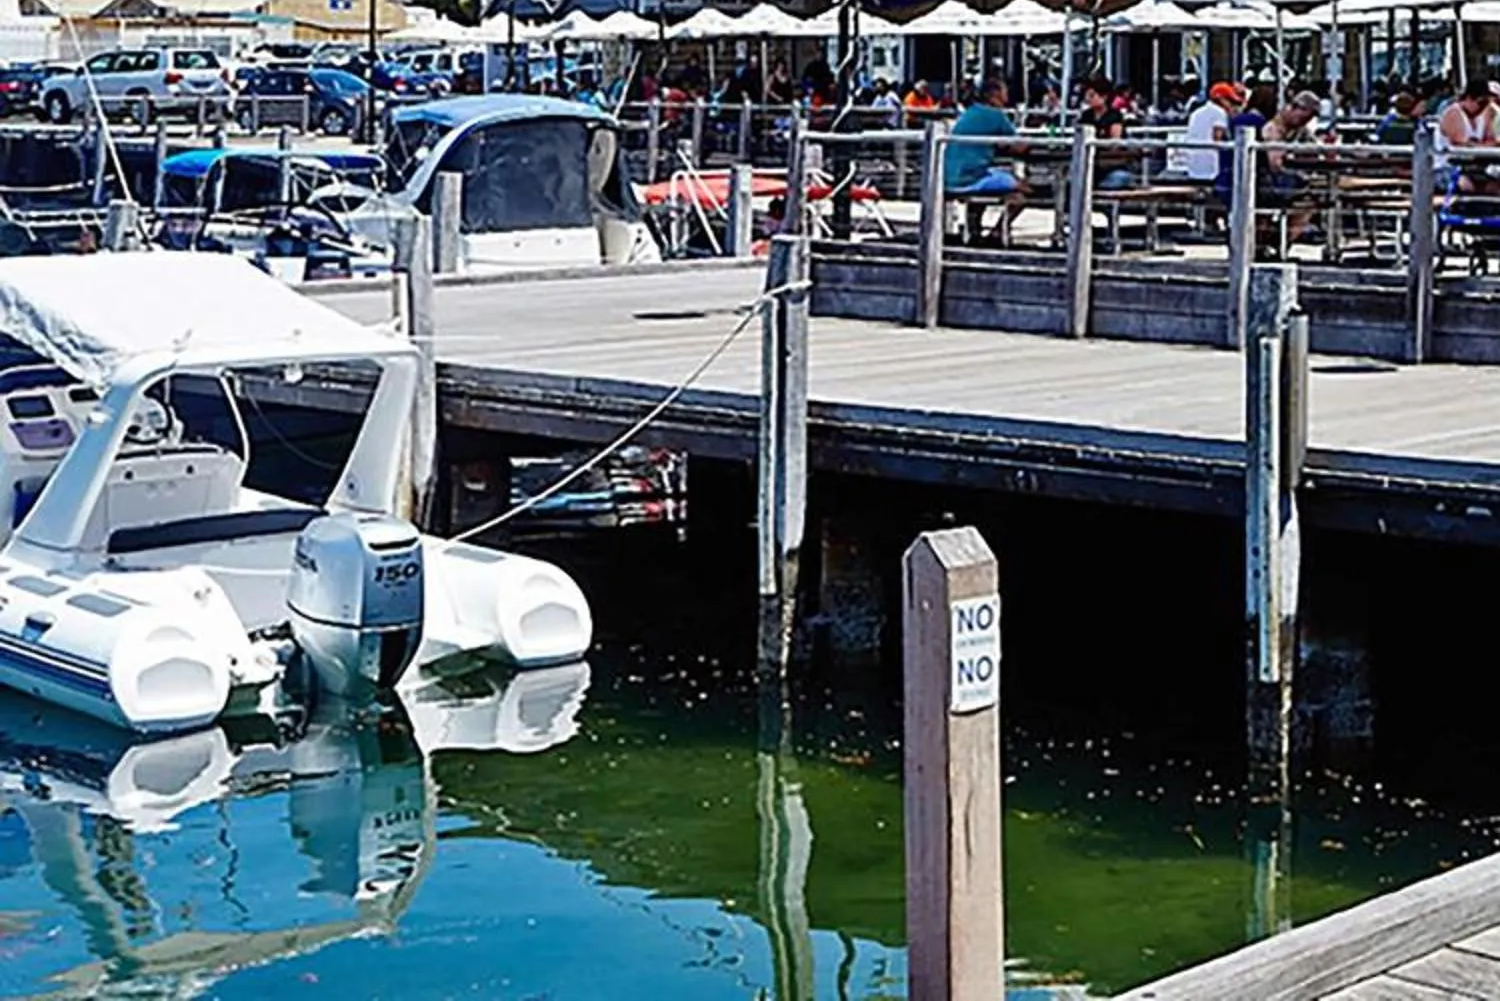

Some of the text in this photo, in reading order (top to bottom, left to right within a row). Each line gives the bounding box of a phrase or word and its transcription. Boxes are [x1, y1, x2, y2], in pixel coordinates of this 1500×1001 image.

[374, 562, 420, 583] 150
[957, 604, 993, 632] NO
[957, 656, 993, 685] NO
